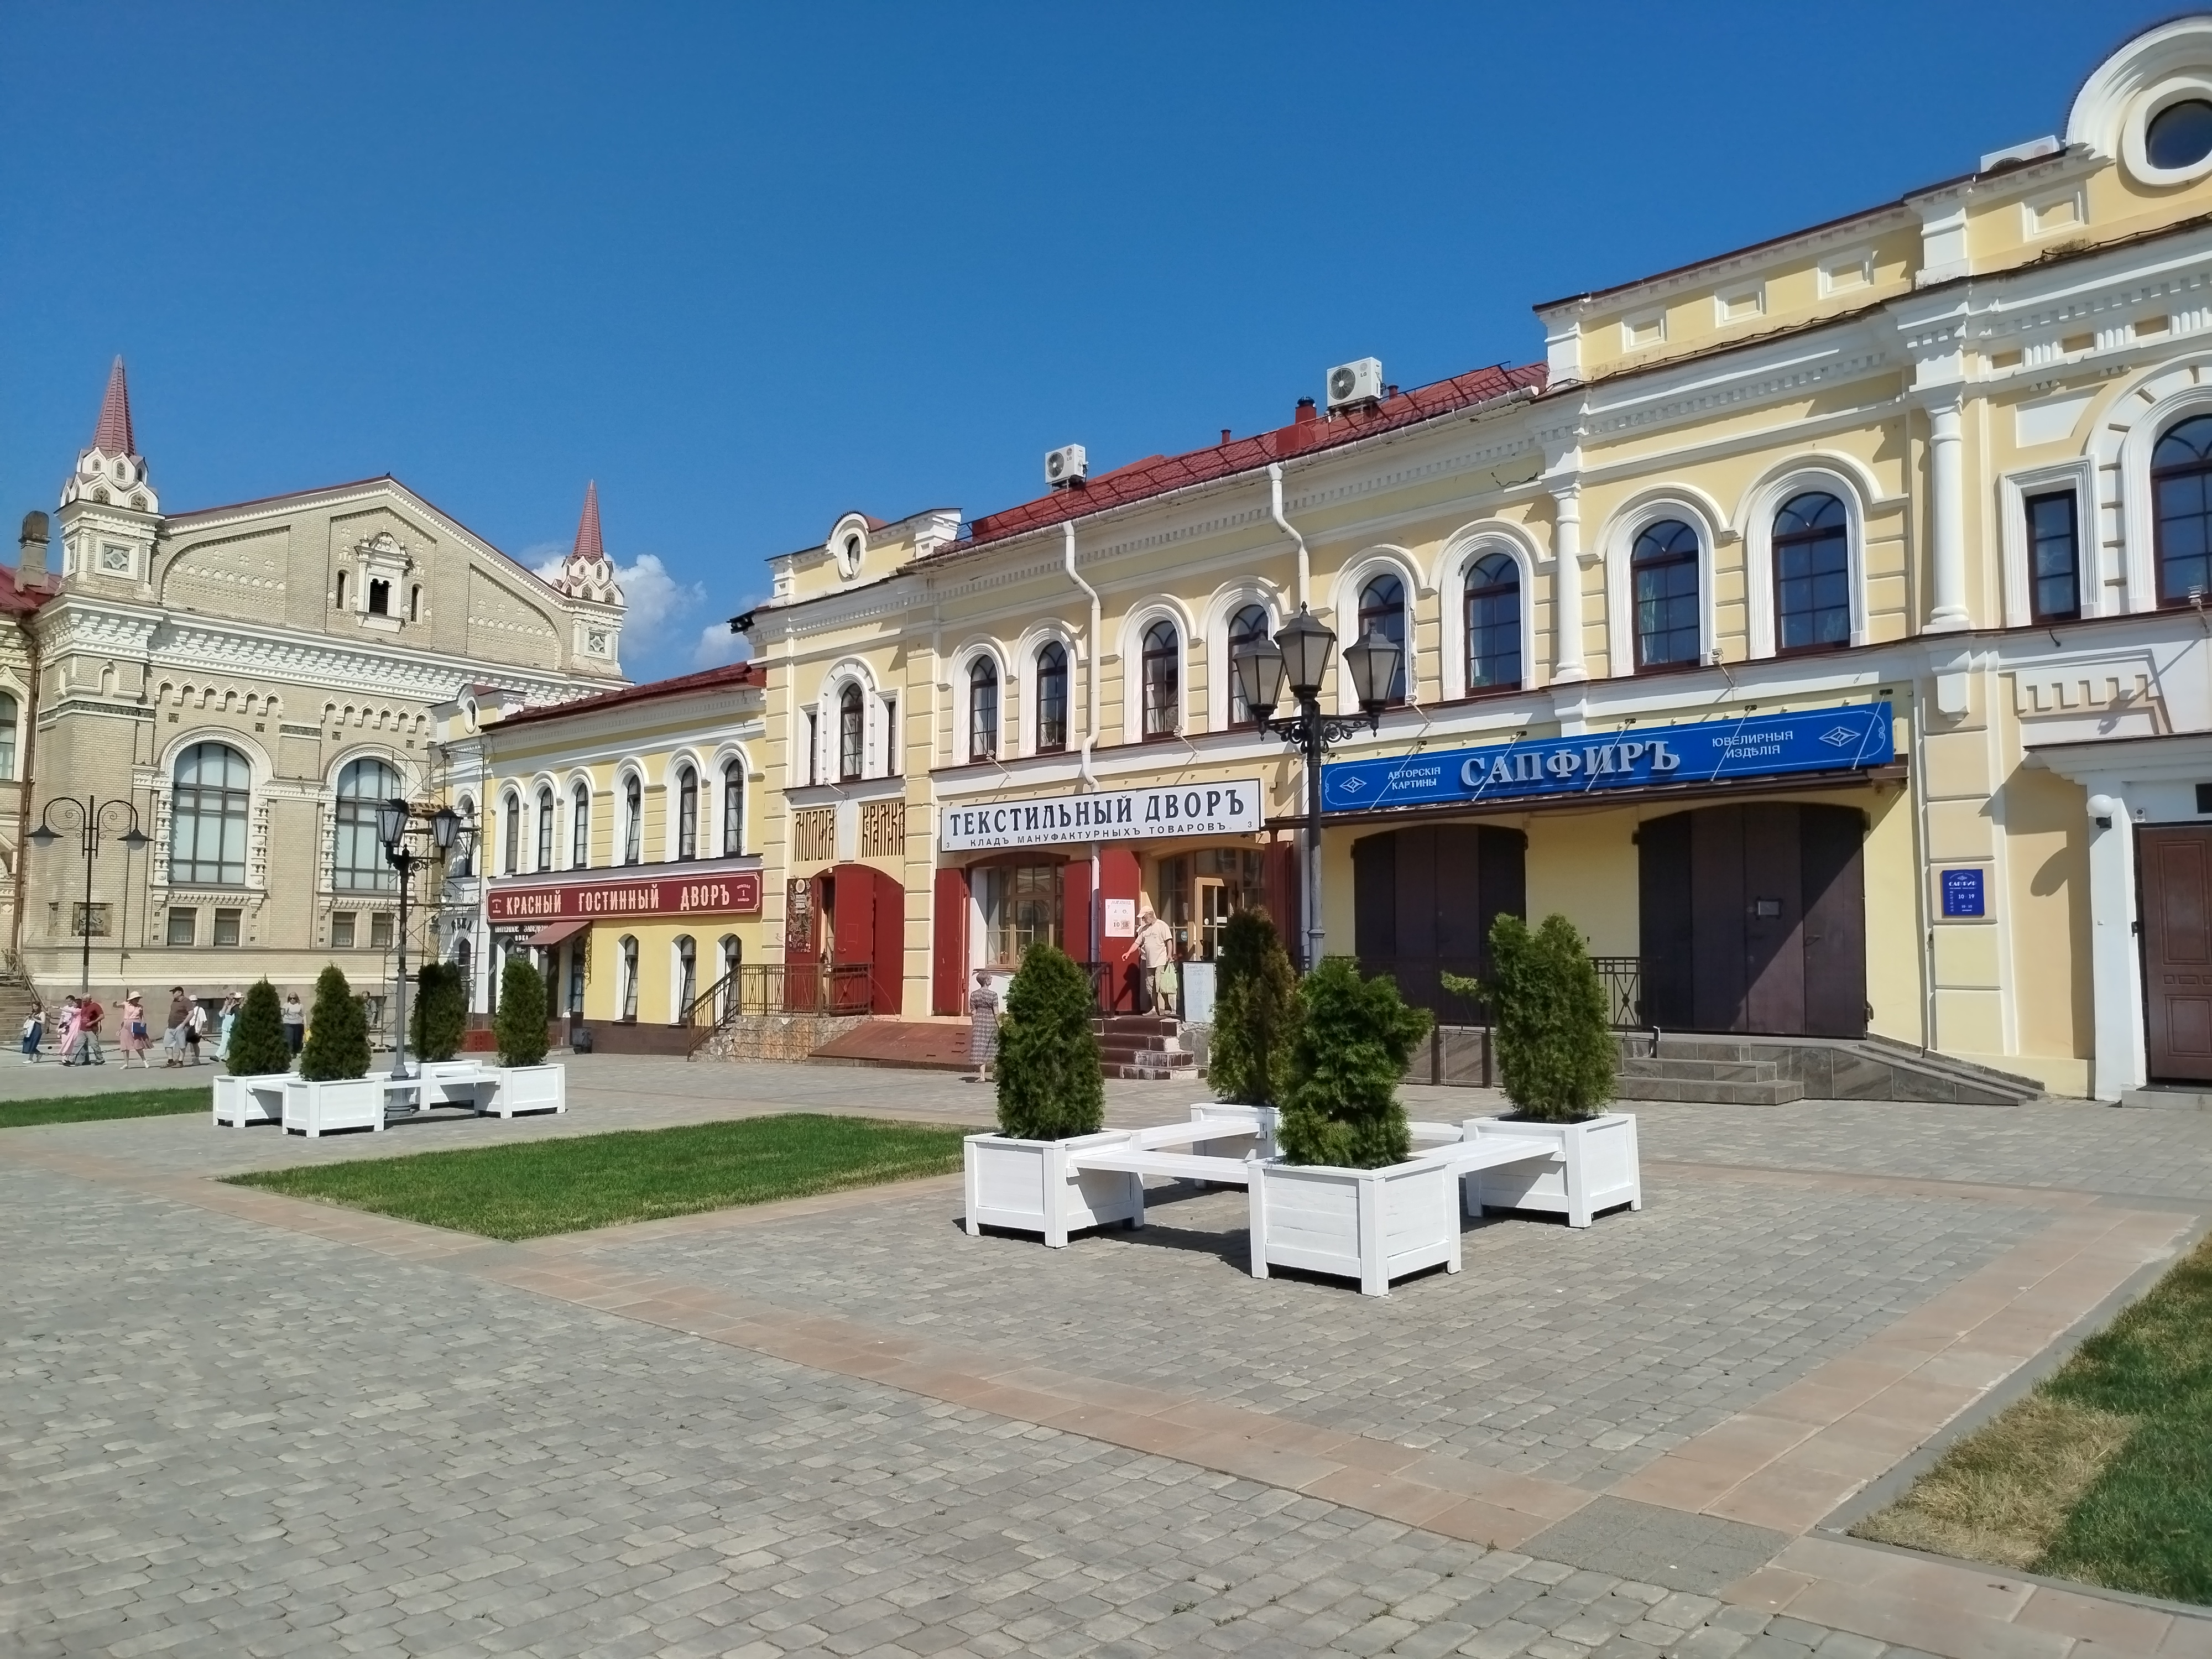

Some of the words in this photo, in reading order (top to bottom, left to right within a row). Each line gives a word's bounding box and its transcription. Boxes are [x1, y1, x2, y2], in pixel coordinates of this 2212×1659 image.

[1712, 731, 1793, 747] ЮВЕЛИРНЫЯ
[1461, 740, 1681, 786] САПФИРЪ
[1387, 766, 1441, 780] АВТОРСКІЯ
[1392, 778, 1437, 790] КАРТИНЫ
[950, 795, 1132, 836] ТЕКСТИЛЬНЫЙ
[1145, 789, 1244, 823] ДВОРЪ
[1018, 827, 1140, 843] МАНУФАКТУРНЫХЪ
[507, 890, 561, 915] КРАСНЫЙ
[578, 884, 659, 912] ГОСТИННЫЙ
[680, 884, 730, 911] ДВОРЪ
